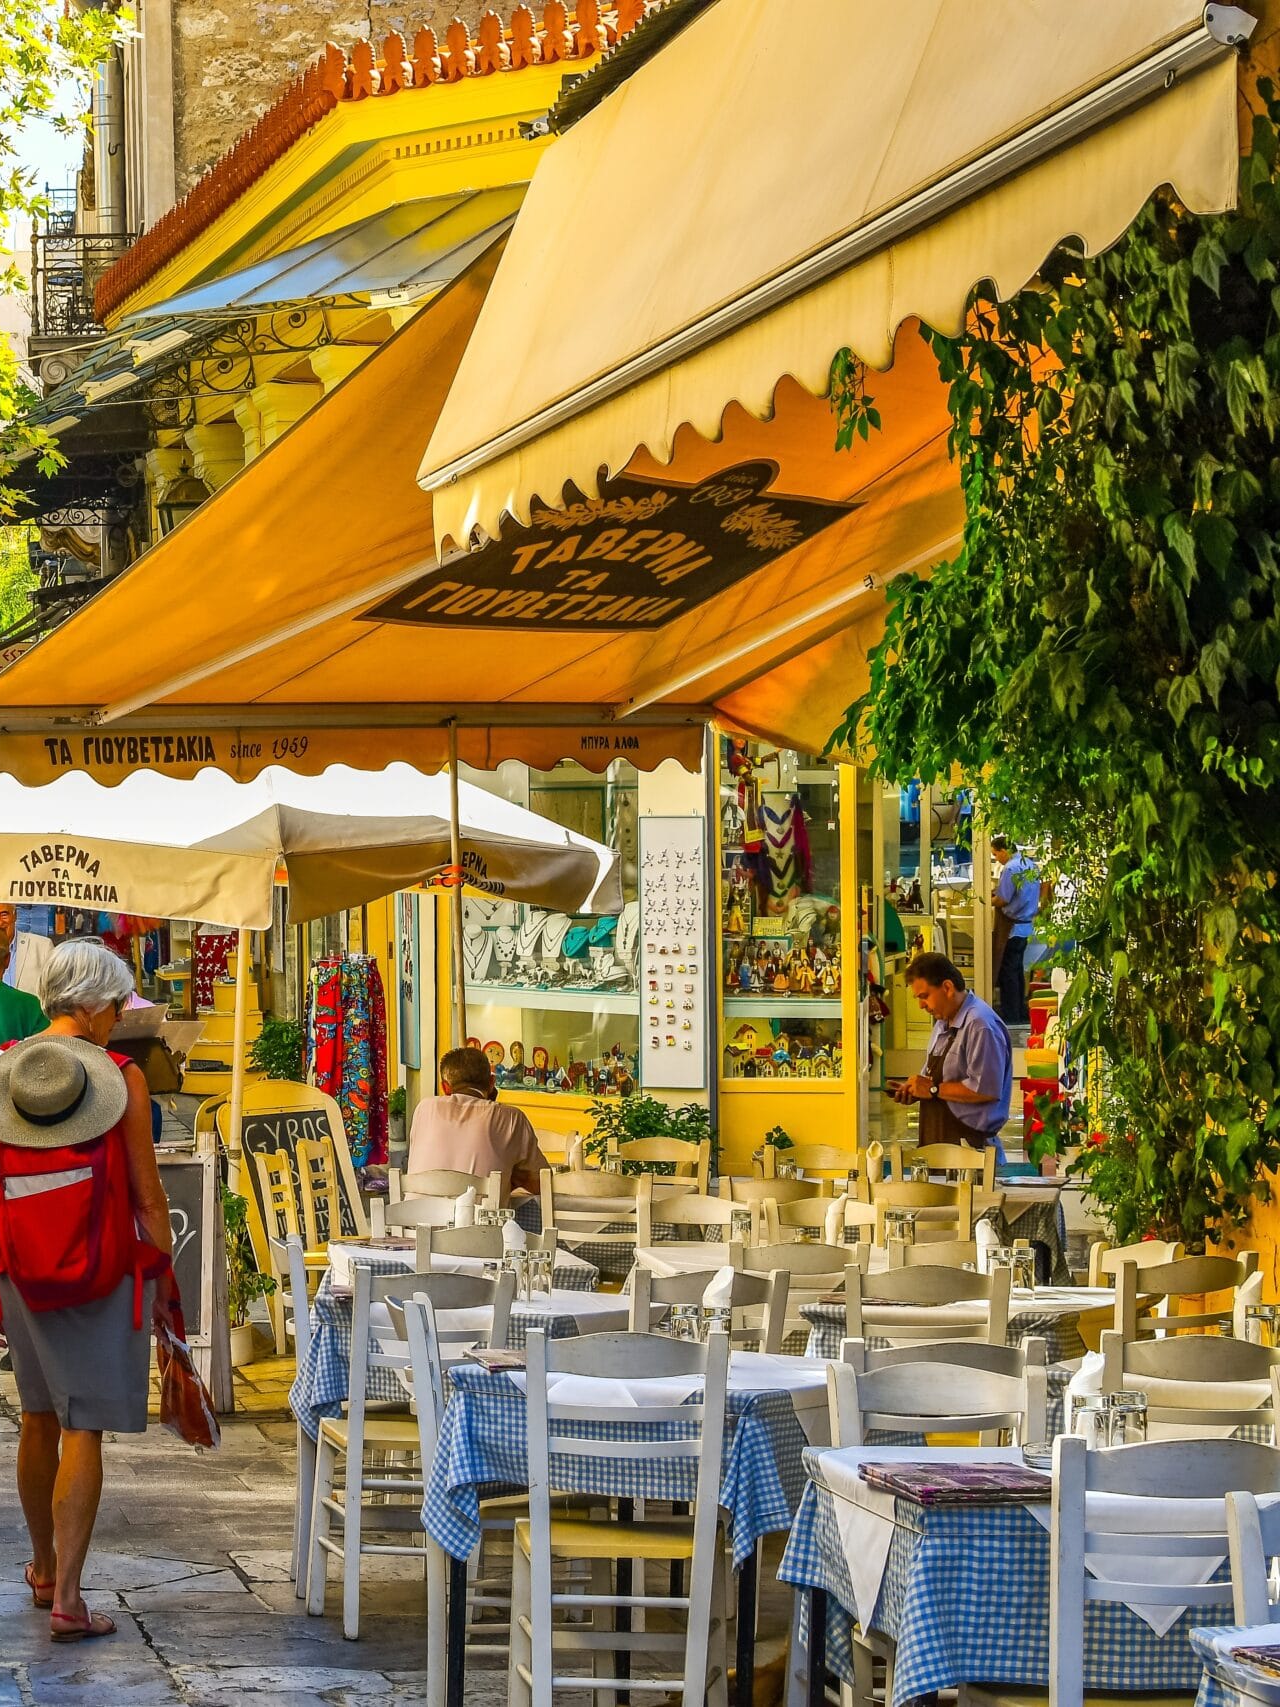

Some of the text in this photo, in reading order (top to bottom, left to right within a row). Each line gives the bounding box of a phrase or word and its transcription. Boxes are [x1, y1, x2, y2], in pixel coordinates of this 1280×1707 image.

[510, 529, 713, 587] ΤΑΒΕΡΝΑ
[556, 569, 610, 590] ΤΑ
[402, 581, 686, 622] ΓΙΟΥΒΕΤΣΑΚΙΑ
[44, 735, 309, 766] ΤΑ ΓΙΟΥΒΕΤΣΑΚΙΑ since 1959
[19, 844, 101, 878] ΤΑΒΕΡΝΑ
[51, 867, 70, 880] ΤΑ
[9, 880, 119, 903] ΓΙΟΥΒΕΤΣΑΚΙΑ
